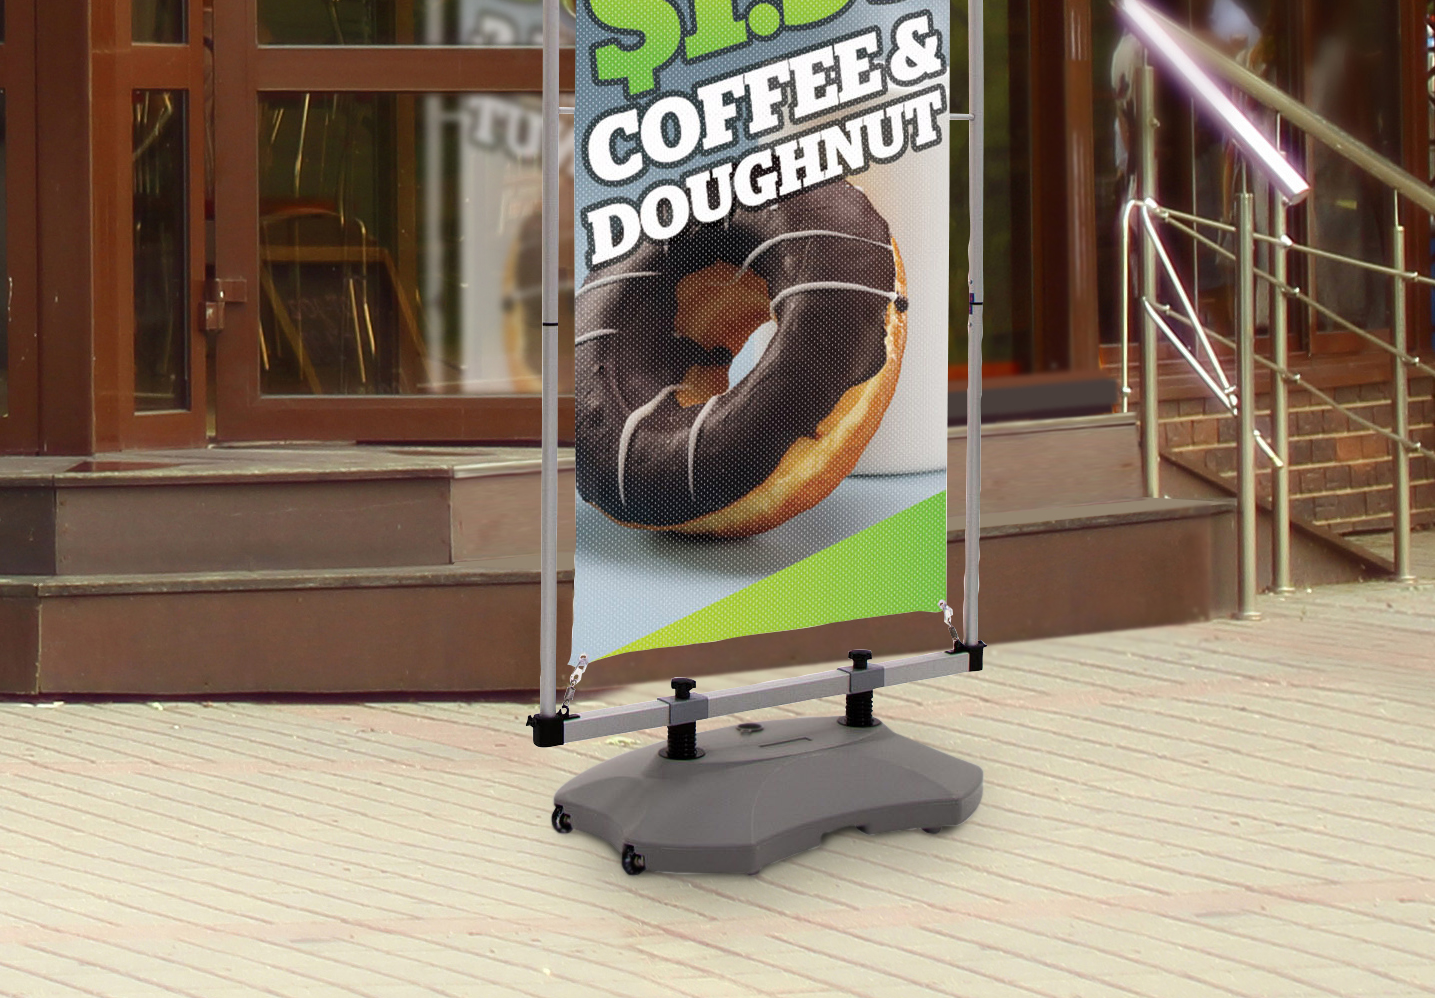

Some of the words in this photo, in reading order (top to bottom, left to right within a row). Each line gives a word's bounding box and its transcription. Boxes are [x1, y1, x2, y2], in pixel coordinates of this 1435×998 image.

[586, 31, 885, 183] COFFEE
[889, 15, 943, 83] &
[586, 91, 944, 267] DOUGHNUT
